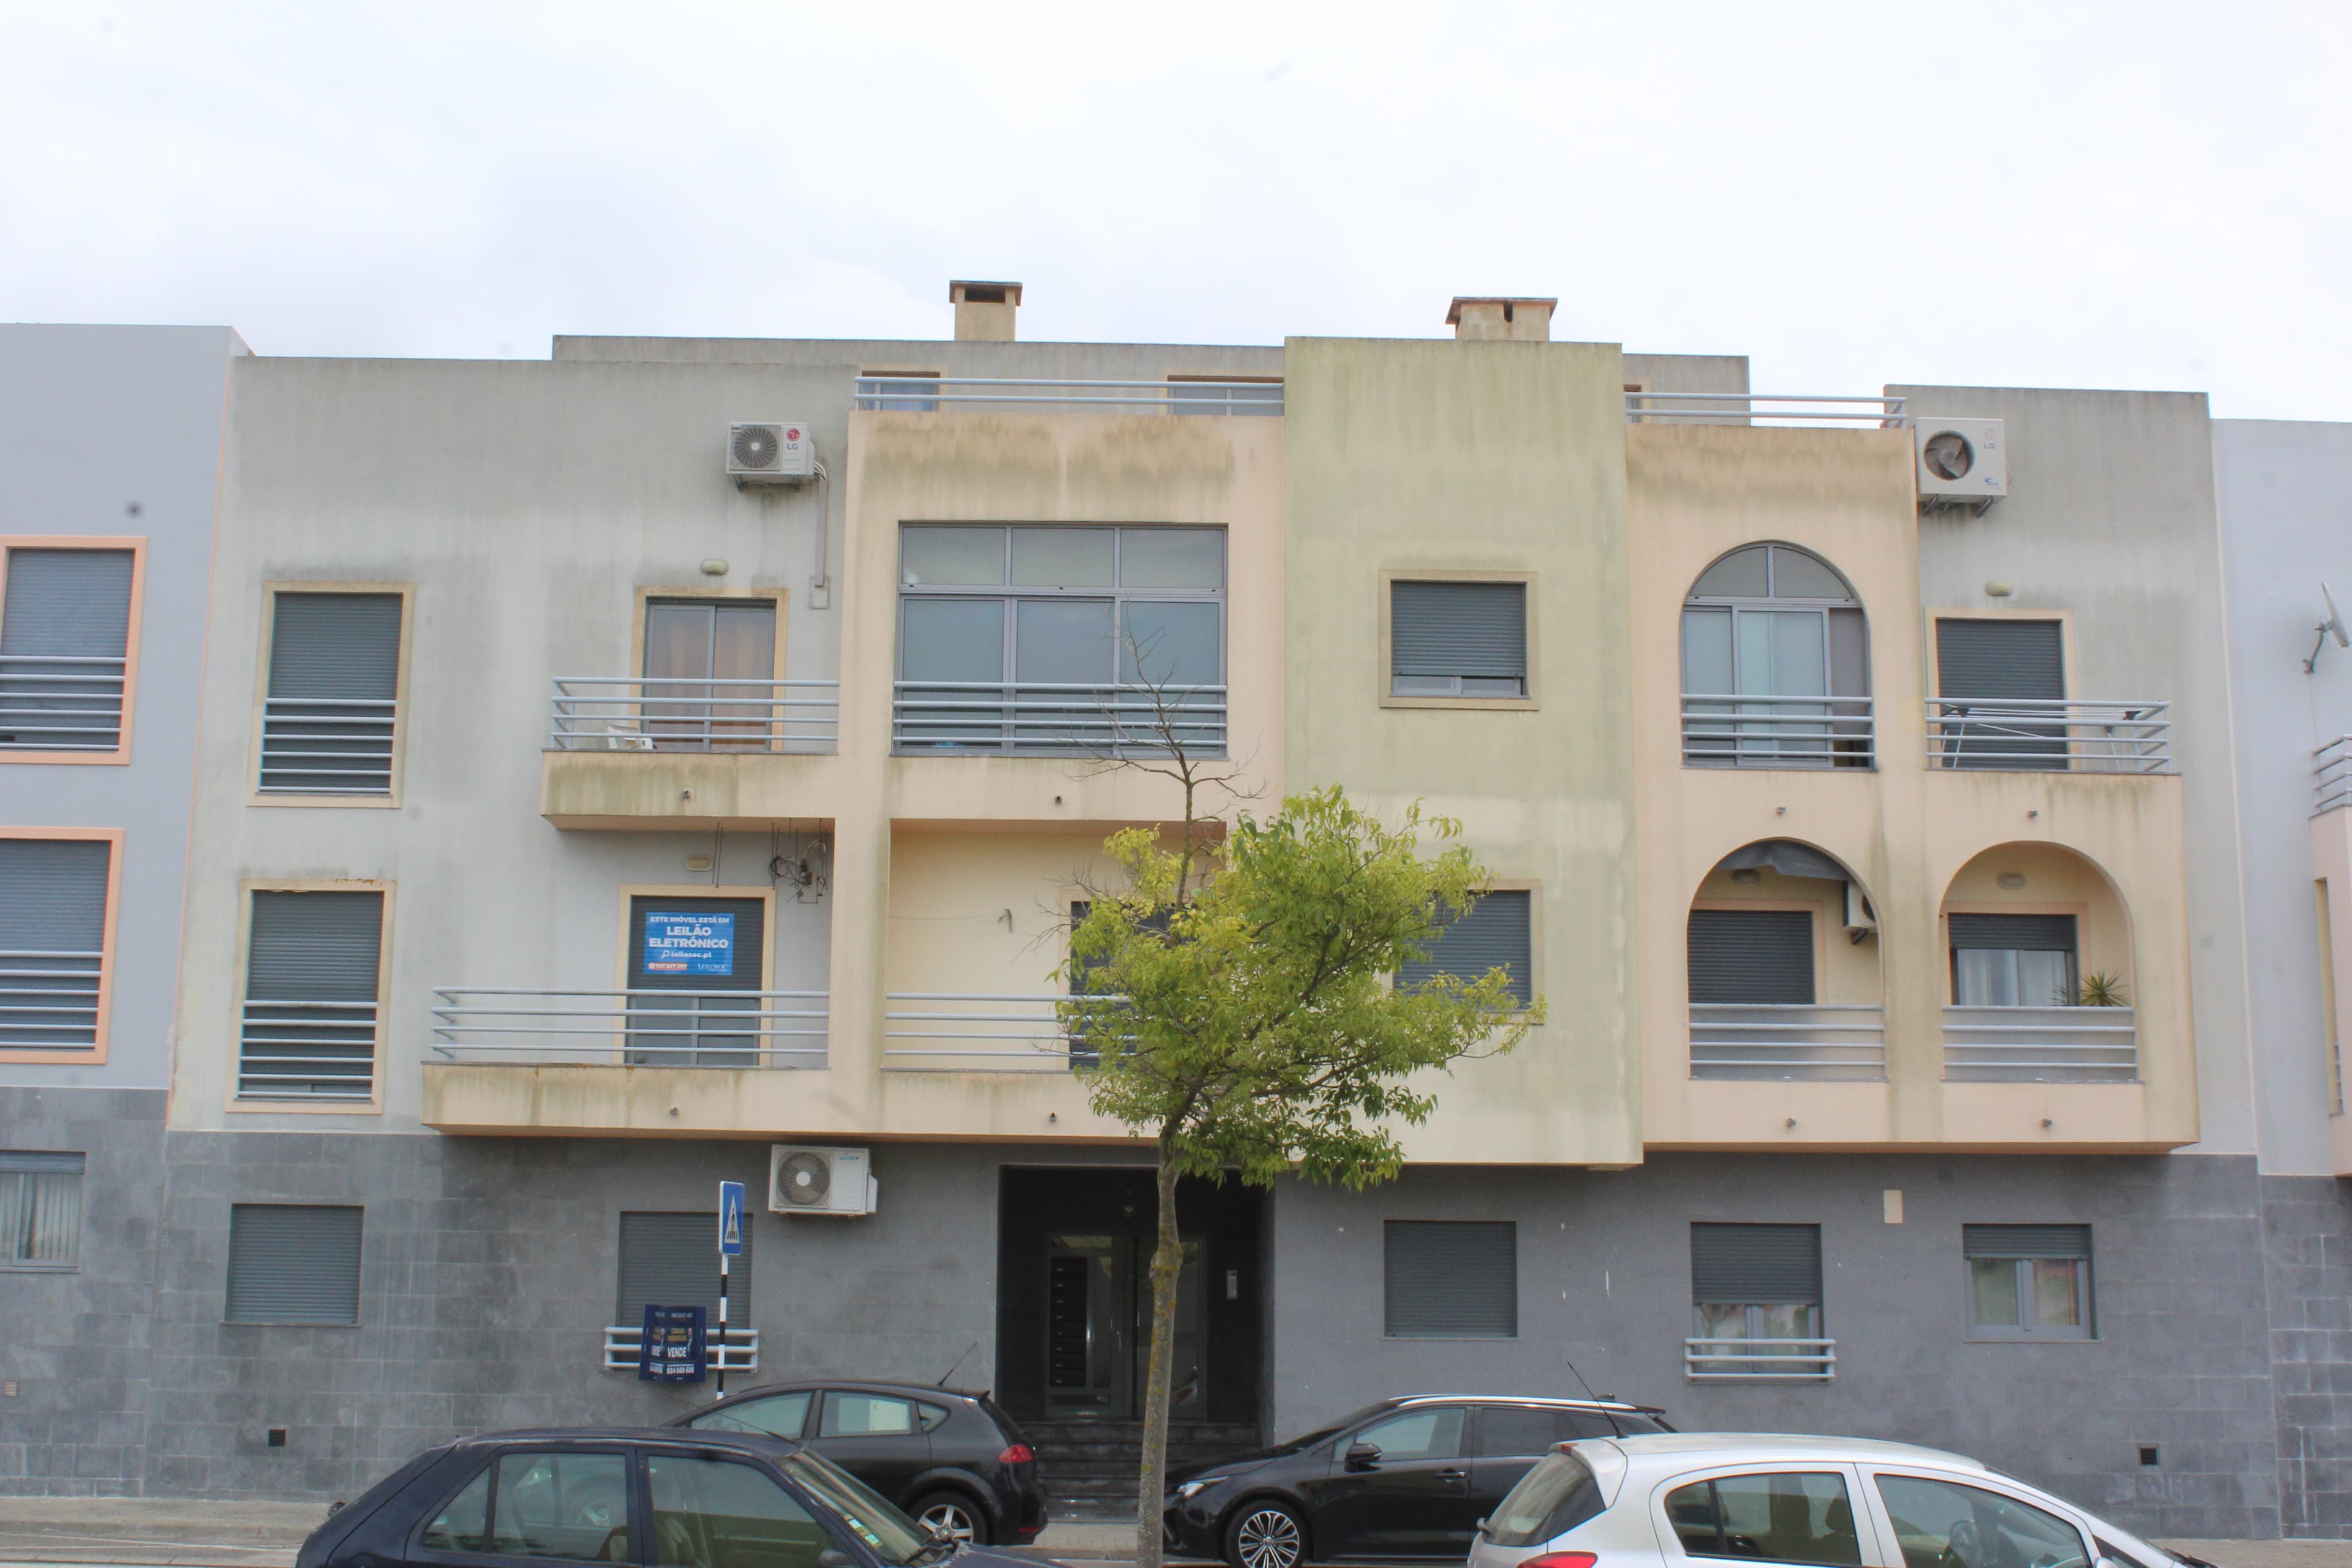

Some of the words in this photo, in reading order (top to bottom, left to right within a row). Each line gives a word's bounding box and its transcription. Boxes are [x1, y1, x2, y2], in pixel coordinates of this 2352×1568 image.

[666, 924, 712, 936] LEILÃO
[649, 936, 729, 949] ELETRÓNICO
[671, 951, 712, 960] leilosoc.pt
[668, 1347, 687, 1358] VENDE
